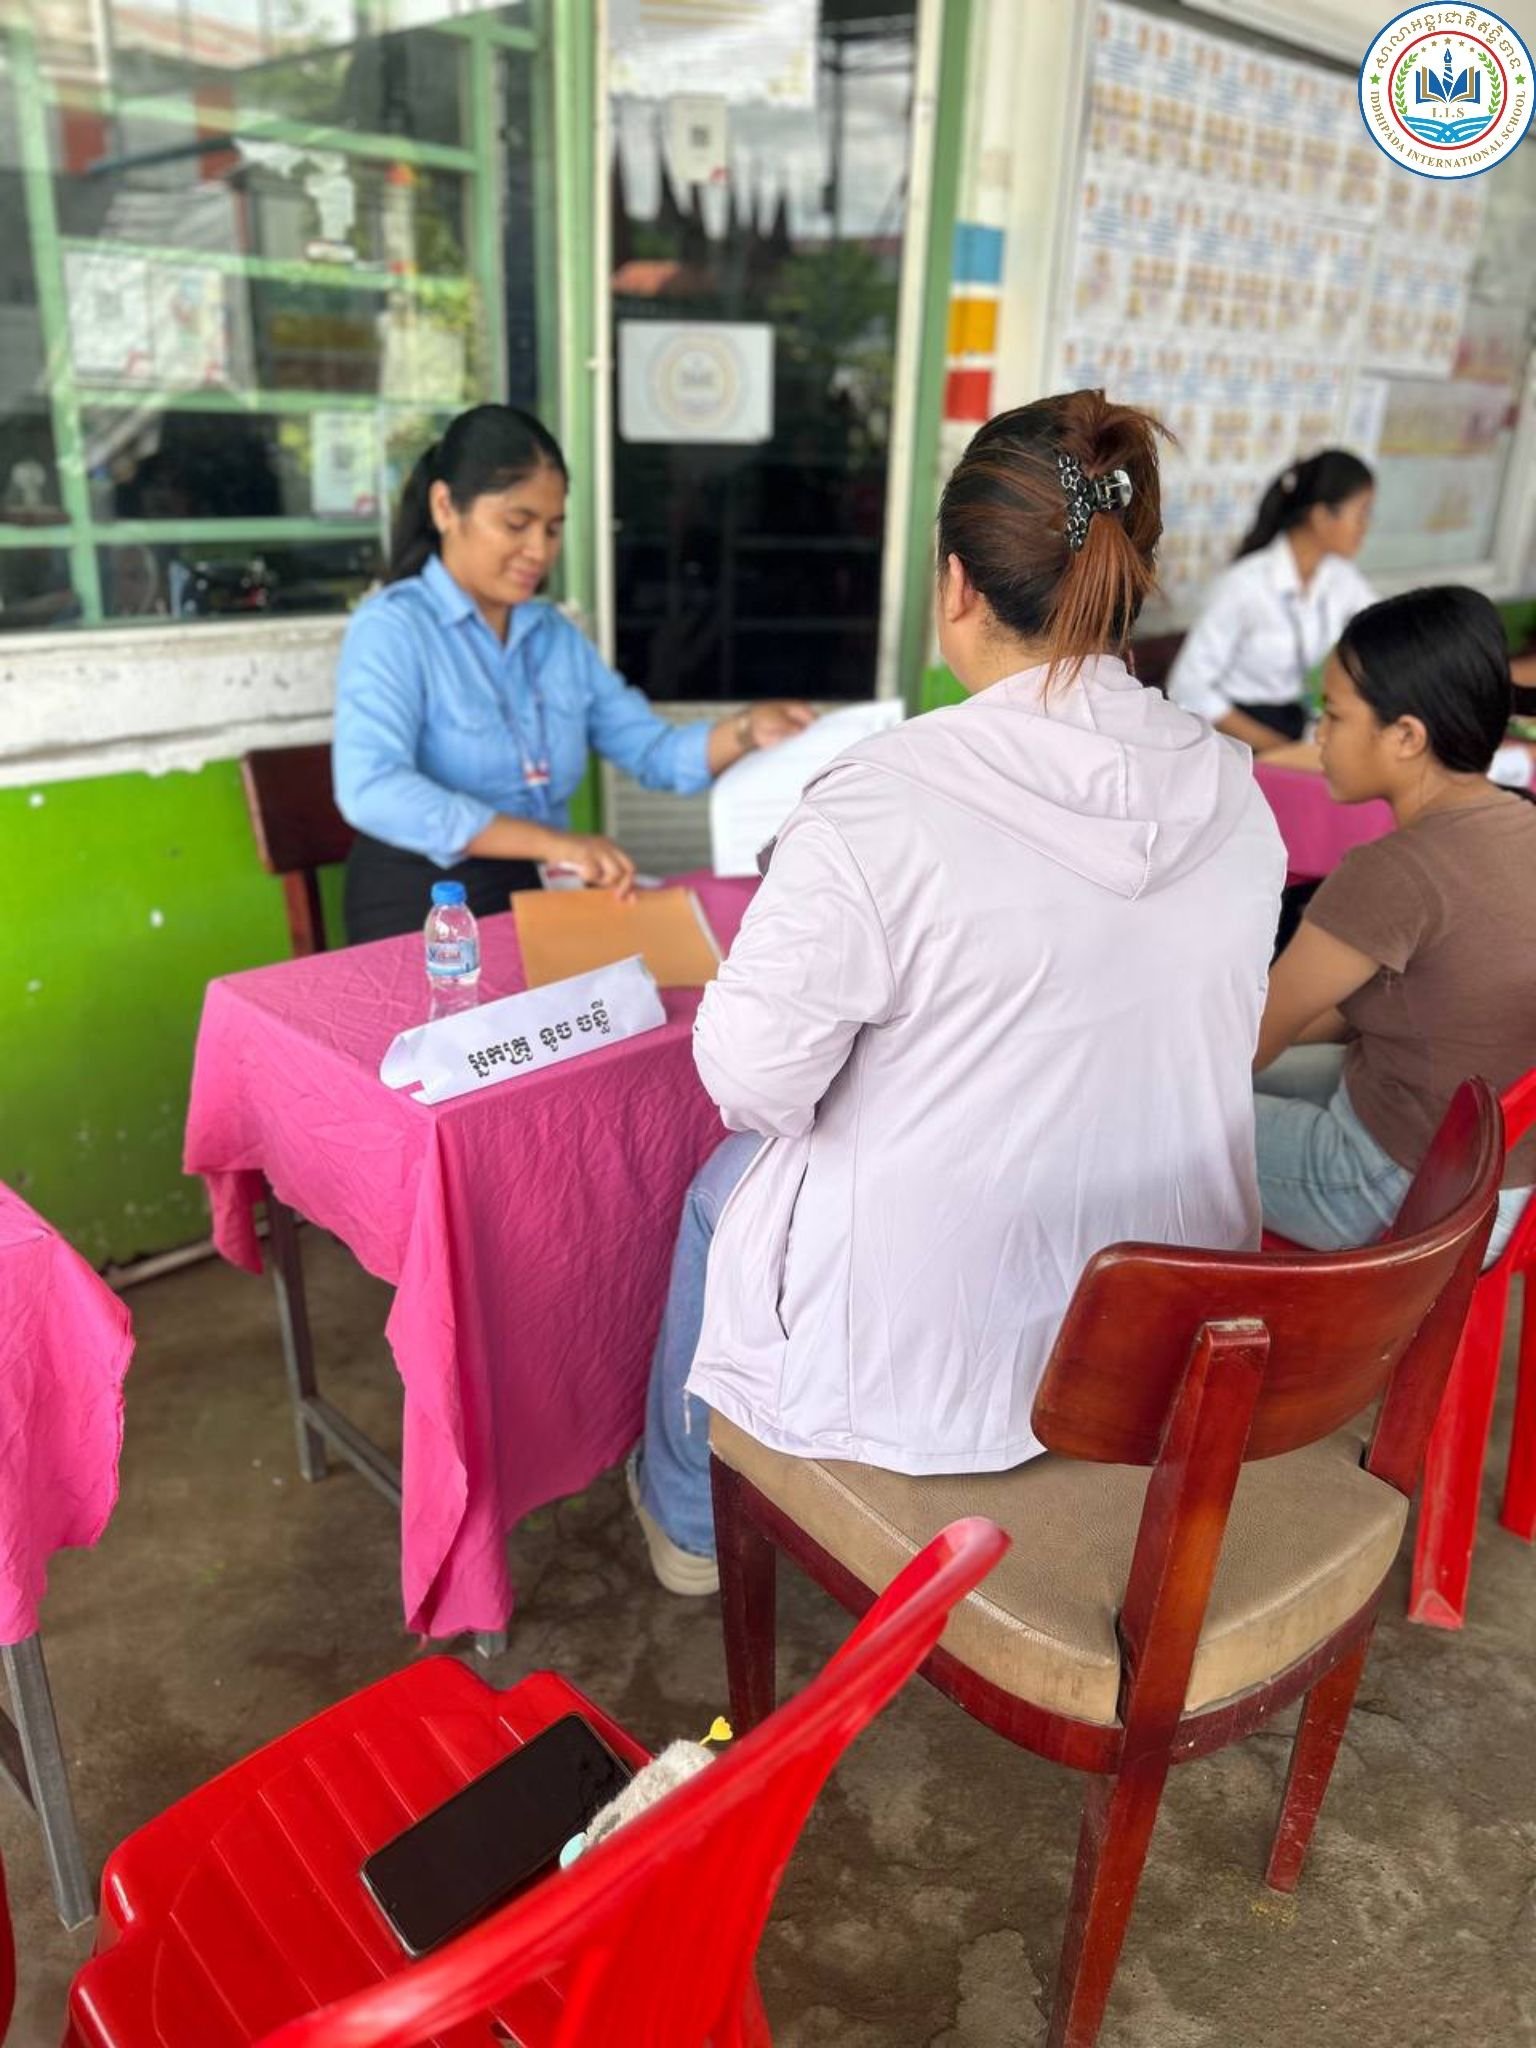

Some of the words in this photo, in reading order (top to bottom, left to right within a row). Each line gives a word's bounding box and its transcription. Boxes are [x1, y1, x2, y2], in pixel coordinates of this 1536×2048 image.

[467, 1035, 534, 1079] អ្នកគ្រូ
[539, 1021, 573, 1052] ទូច
